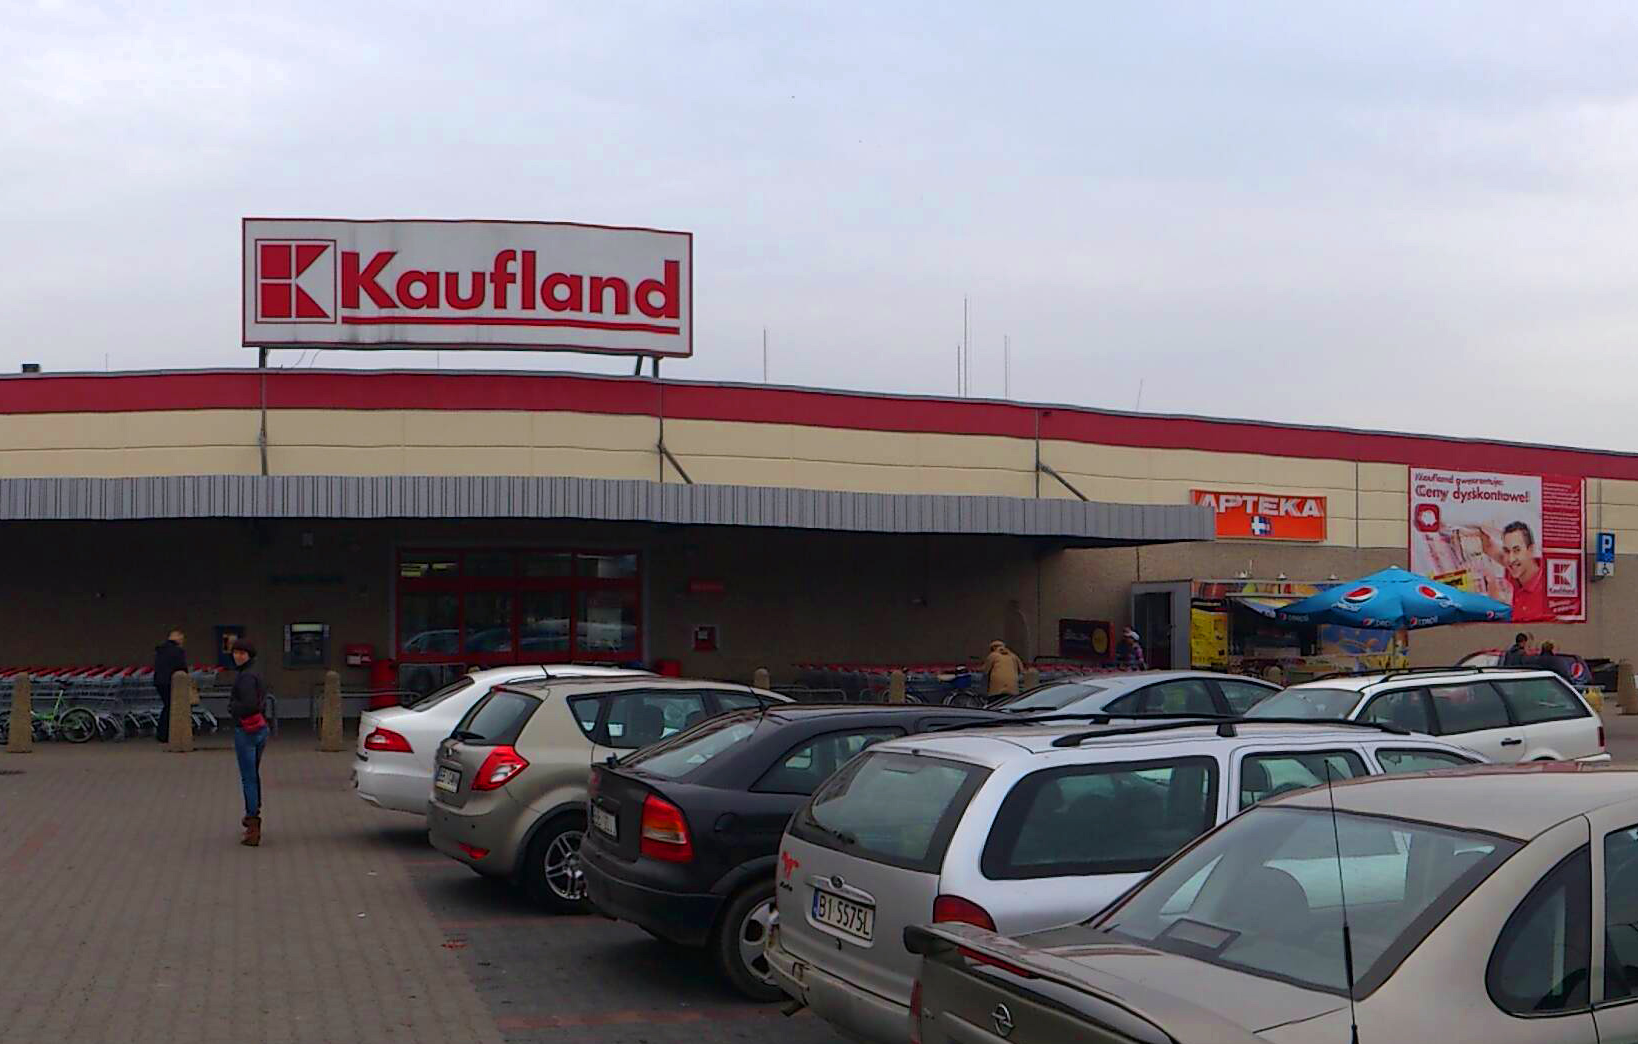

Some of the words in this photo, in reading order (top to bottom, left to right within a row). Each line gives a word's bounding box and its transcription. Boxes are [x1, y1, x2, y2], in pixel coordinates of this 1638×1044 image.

[341, 249, 681, 320] Kaufland
[1415, 484, 1449, 502] Ceny
[1201, 494, 1324, 517] APTEKA
[1602, 535, 1613, 553] P
[819, 894, 833, 921] BI
[836, 901, 870, 936] 5575L
